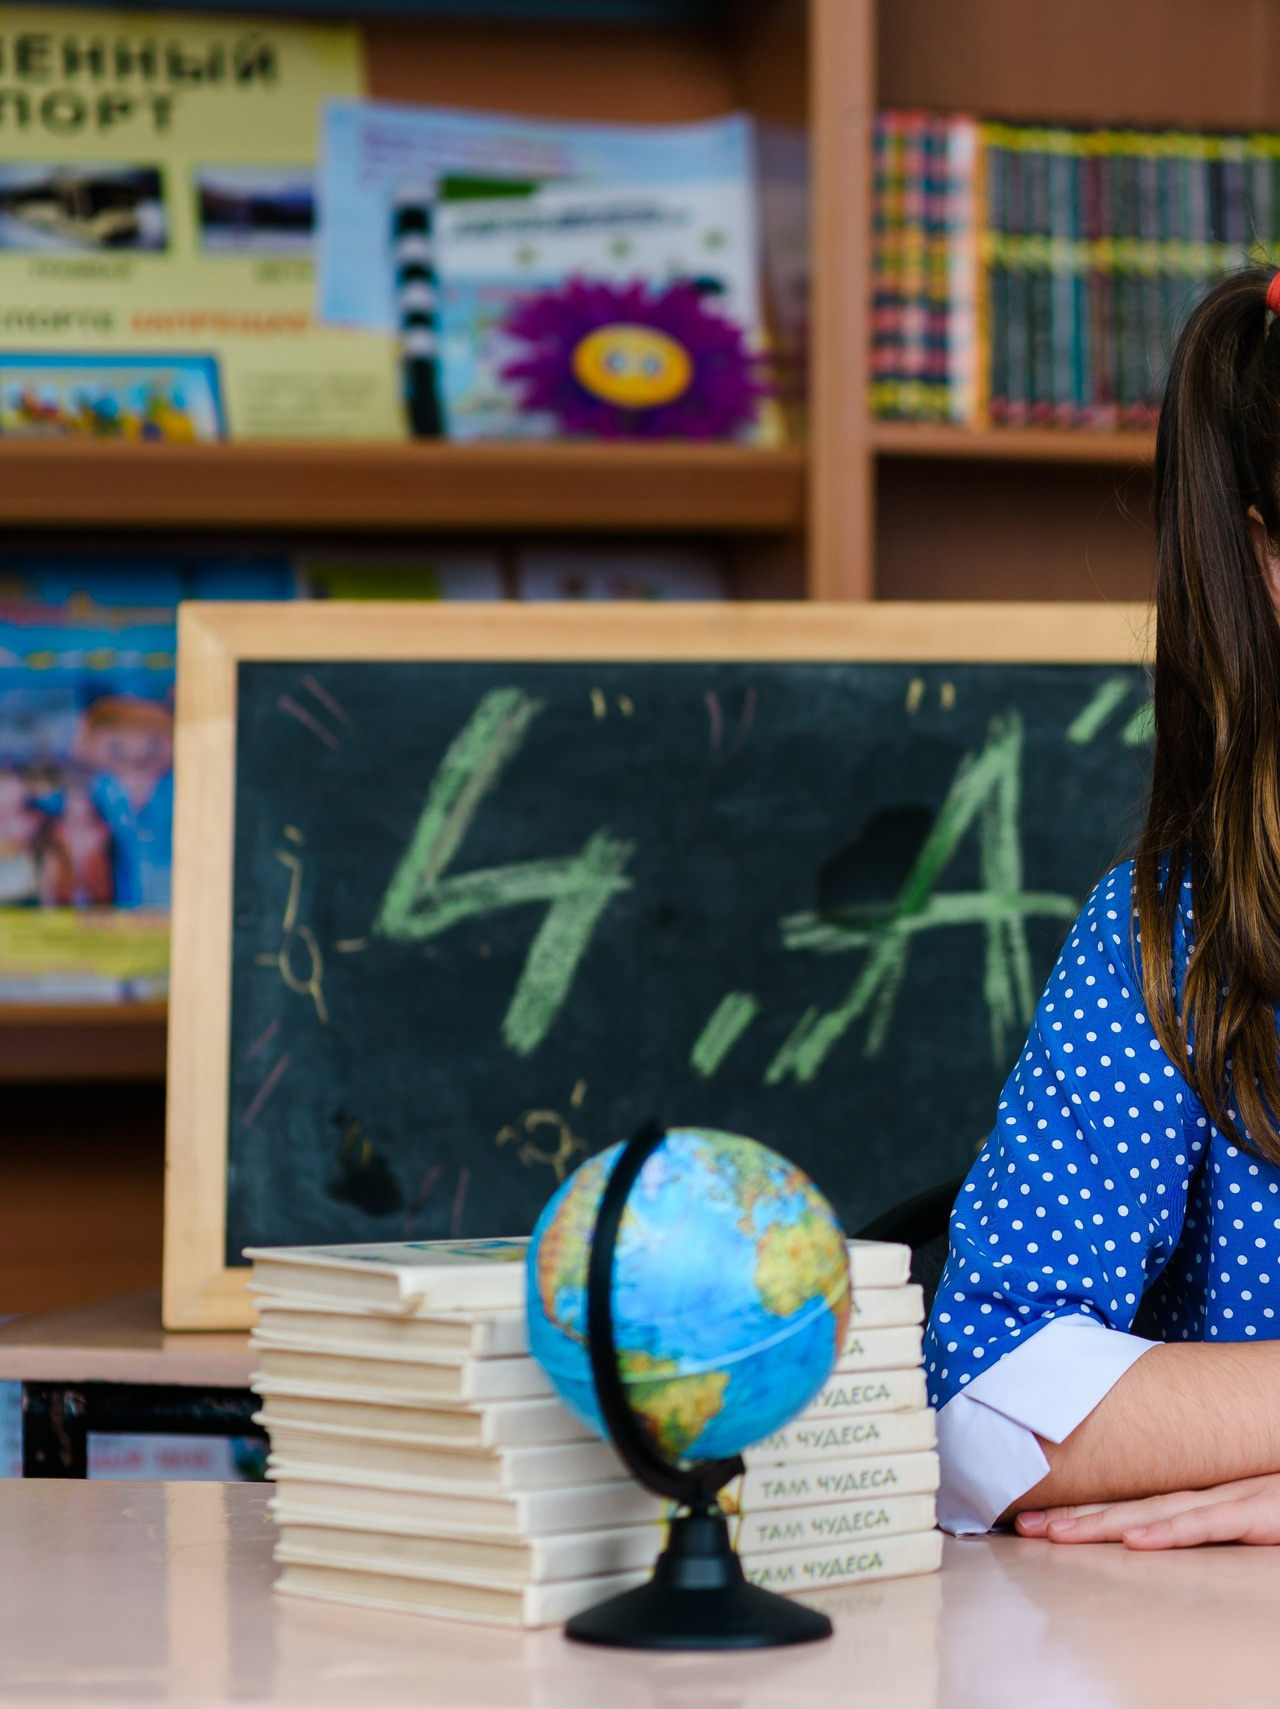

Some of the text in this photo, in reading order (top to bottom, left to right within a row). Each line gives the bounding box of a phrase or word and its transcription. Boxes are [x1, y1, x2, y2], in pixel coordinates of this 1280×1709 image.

[378, 686, 634, 1056] 4
[796, 1424, 880, 1448] ЧУДЕСА
[760, 1467, 899, 1499] ТАМ ЧУДЕСА
[756, 1508, 891, 1543] ТАМ ЧУДЕСА
[746, 1551, 884, 1586] ТАМ ЧУДЕСА
